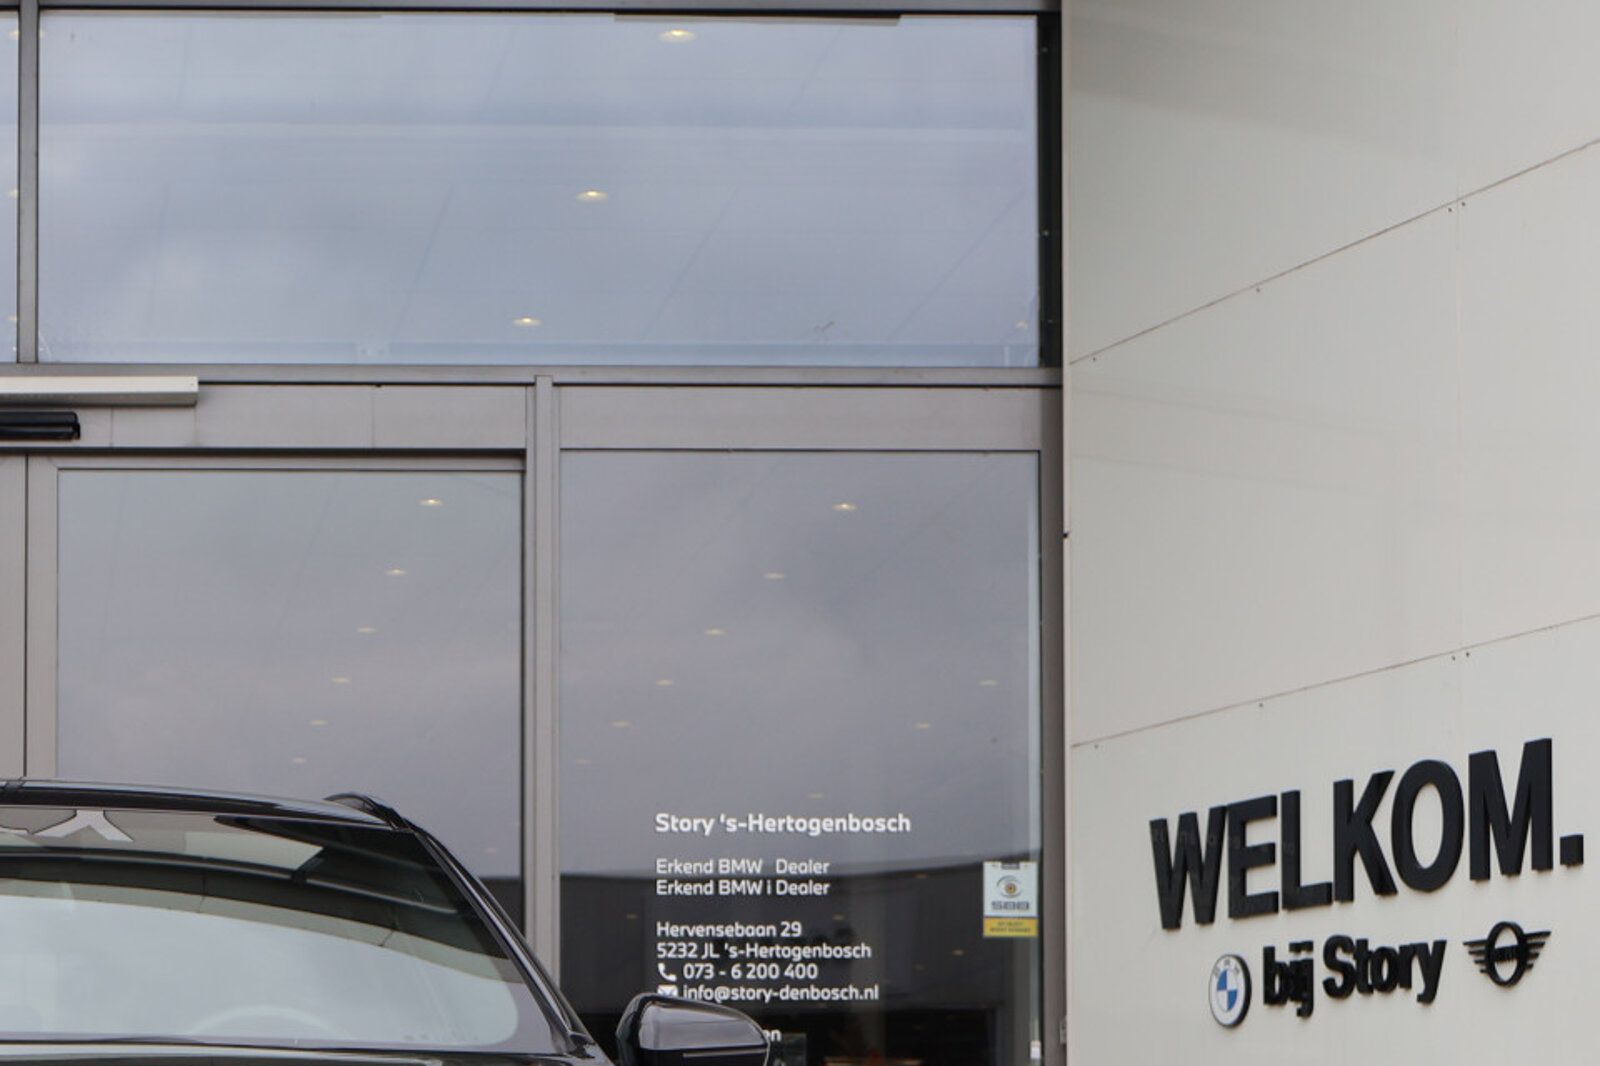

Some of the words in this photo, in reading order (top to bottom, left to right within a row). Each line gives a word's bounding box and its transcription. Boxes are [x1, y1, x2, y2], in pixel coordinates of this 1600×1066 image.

[655, 813, 715, 836] Story
[1150, 738, 1584, 930] WELKOM.
[656, 858, 714, 874] Erkend
[718, 858, 763, 874] BMW
[776, 858, 830, 874] Dealer
[656, 880, 714, 896] Erkend
[718, 880, 763, 896] BMW
[766, 880, 772, 896] i
[776, 880, 830, 896] Dealer
[656, 922, 777, 938] Hervensebaan
[780, 922, 802, 938] 29
[656, 943, 698, 958] 5232
[701, 943, 720, 958] JL
[724, 942, 872, 962] 's-Hertogenbosch
[683, 963, 715, 980] 073
[731, 963, 742, 980] 6
[746, 963, 779, 980] 200
[784, 963, 818, 980] 400
[1262, 941, 1314, 1018] bij
[1322, 934, 1447, 1005] Story
[683, 984, 880, 1004] info@story-denbosch.nl
